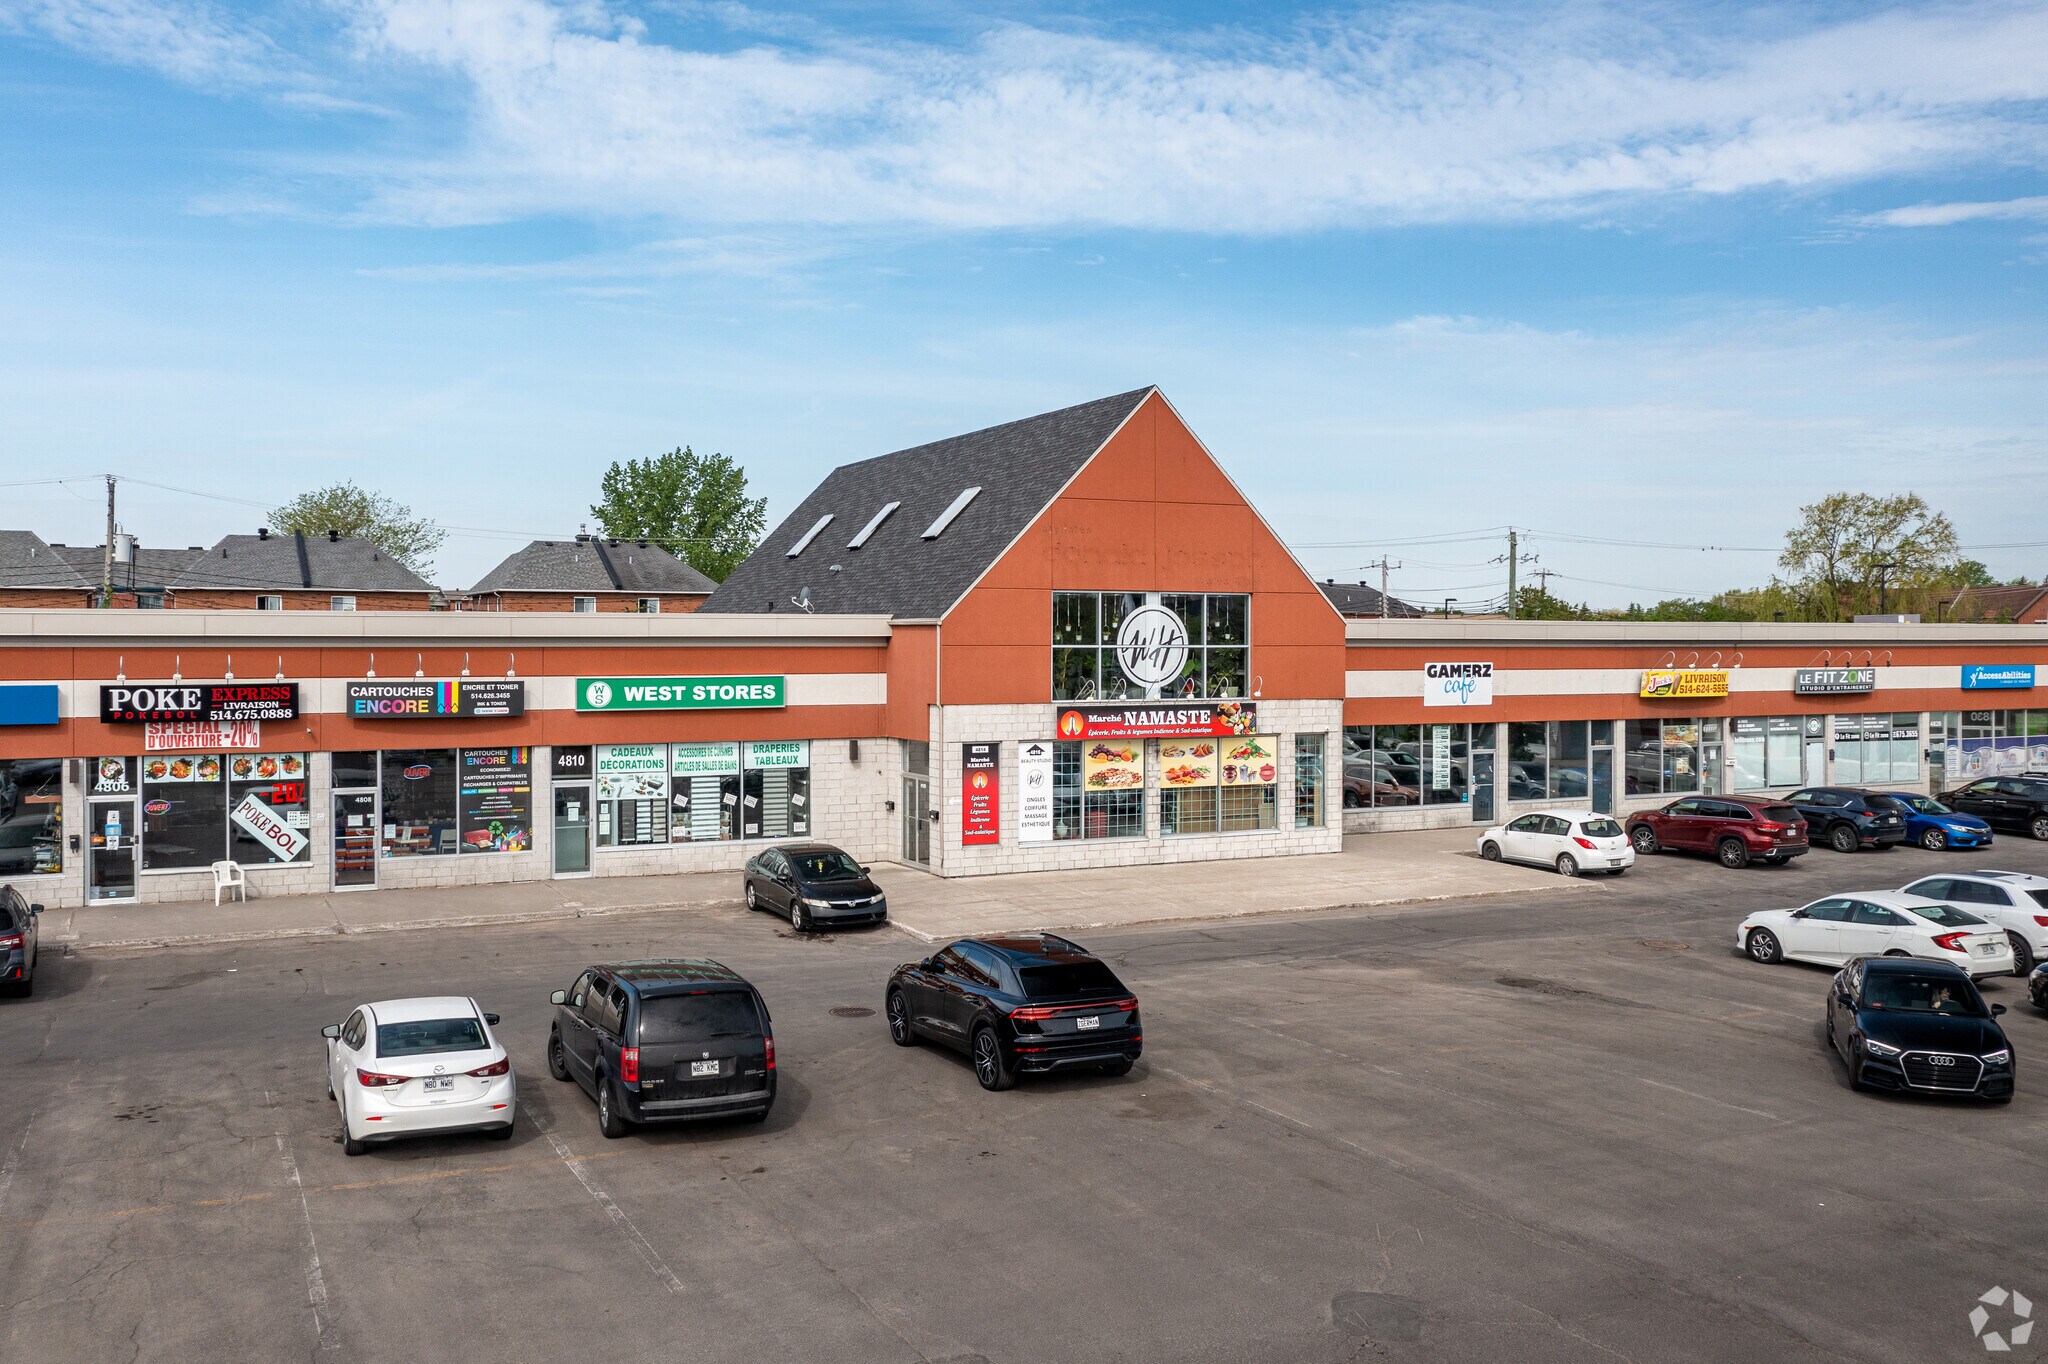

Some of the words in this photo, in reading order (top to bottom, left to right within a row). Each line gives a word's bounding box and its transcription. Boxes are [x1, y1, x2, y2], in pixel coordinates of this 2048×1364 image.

[1426, 664, 1492, 678] GAMERZ
[1800, 674, 1811, 683] LE
[1814, 671, 1837, 683] FIT
[1839, 670, 1873, 683] ZONE
[1977, 670, 2031, 679] AccessAbilities
[1648, 675, 1672, 691] Jack's
[1684, 674, 1726, 683] LIVRAISON
[211, 686, 291, 701] EXPRESS
[350, 687, 434, 697] CARTOUCHES
[624, 686, 686, 701] WEST
[692, 684, 776, 700] STORES
[1444, 671, 1477, 704] café
[1679, 684, 1728, 694] 514-624-5555
[108, 688, 202, 711] POKE
[223, 701, 279, 710] LIVRAISON
[355, 700, 429, 714] ENCORE
[114, 711, 197, 719] POKEBOL
[210, 709, 292, 720] 514.675.0888
[1088, 713, 1122, 723] Marché
[1123, 709, 1211, 726] NAMASTE
[148, 721, 222, 734] SPECIAL
[224, 720, 258, 747] -20%
[1132, 728, 1153, 736] légumes
[148, 734, 222, 748] D'OUVERTURE
[610, 747, 654, 757] CADEAUX
[678, 747, 707, 758] ACCESSOIRES
[707, 747, 713, 757] DE
[714, 746, 733, 757] CUISINES
[753, 743, 801, 754] DRAPERIES
[466, 756, 506, 766] ENCORE
[558, 754, 585, 767] 4810
[600, 758, 665, 770] DÉCORATIONS
[674, 761, 695, 772] ARTICLES
[695, 761, 701, 771] DE
[702, 760, 717, 771] SALLES
[718, 760, 724, 770] DE
[724, 760, 737, 770] BAINS
[754, 755, 799, 765] TABLEAUX
[404, 767, 431, 777] OUVERT
[94, 781, 130, 792] 4806
[146, 803, 169, 811] OUVERT
[237, 801, 272, 831] POKE
[265, 823, 297, 856] BOL
